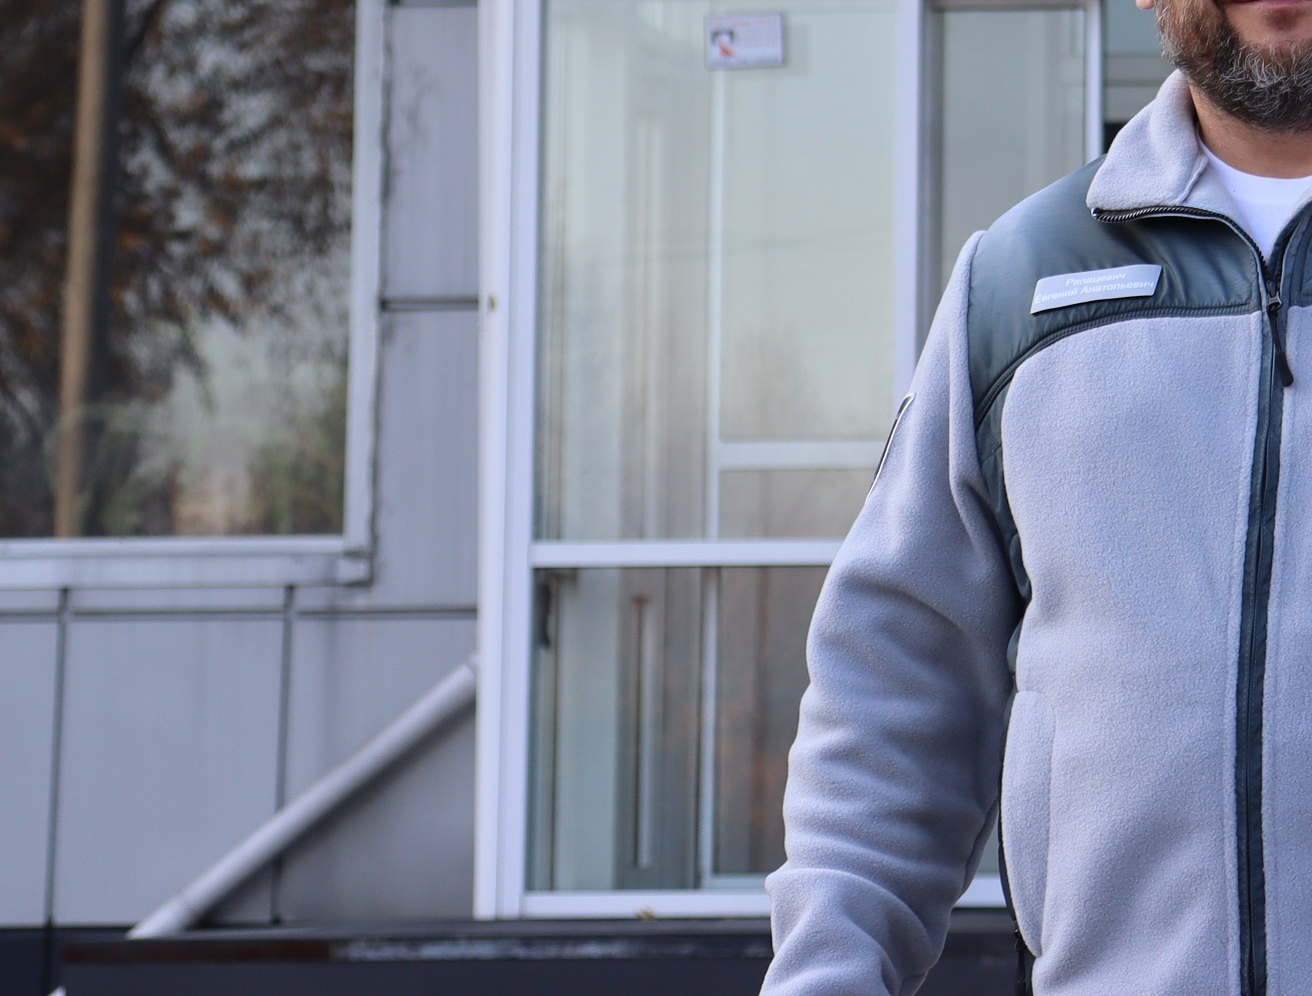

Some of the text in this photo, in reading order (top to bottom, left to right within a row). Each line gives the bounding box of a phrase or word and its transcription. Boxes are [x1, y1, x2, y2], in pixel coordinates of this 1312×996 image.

[1065, 273, 1126, 287] Рапацевич
[1035, 281, 1154, 303] Евгений Анатольевич
